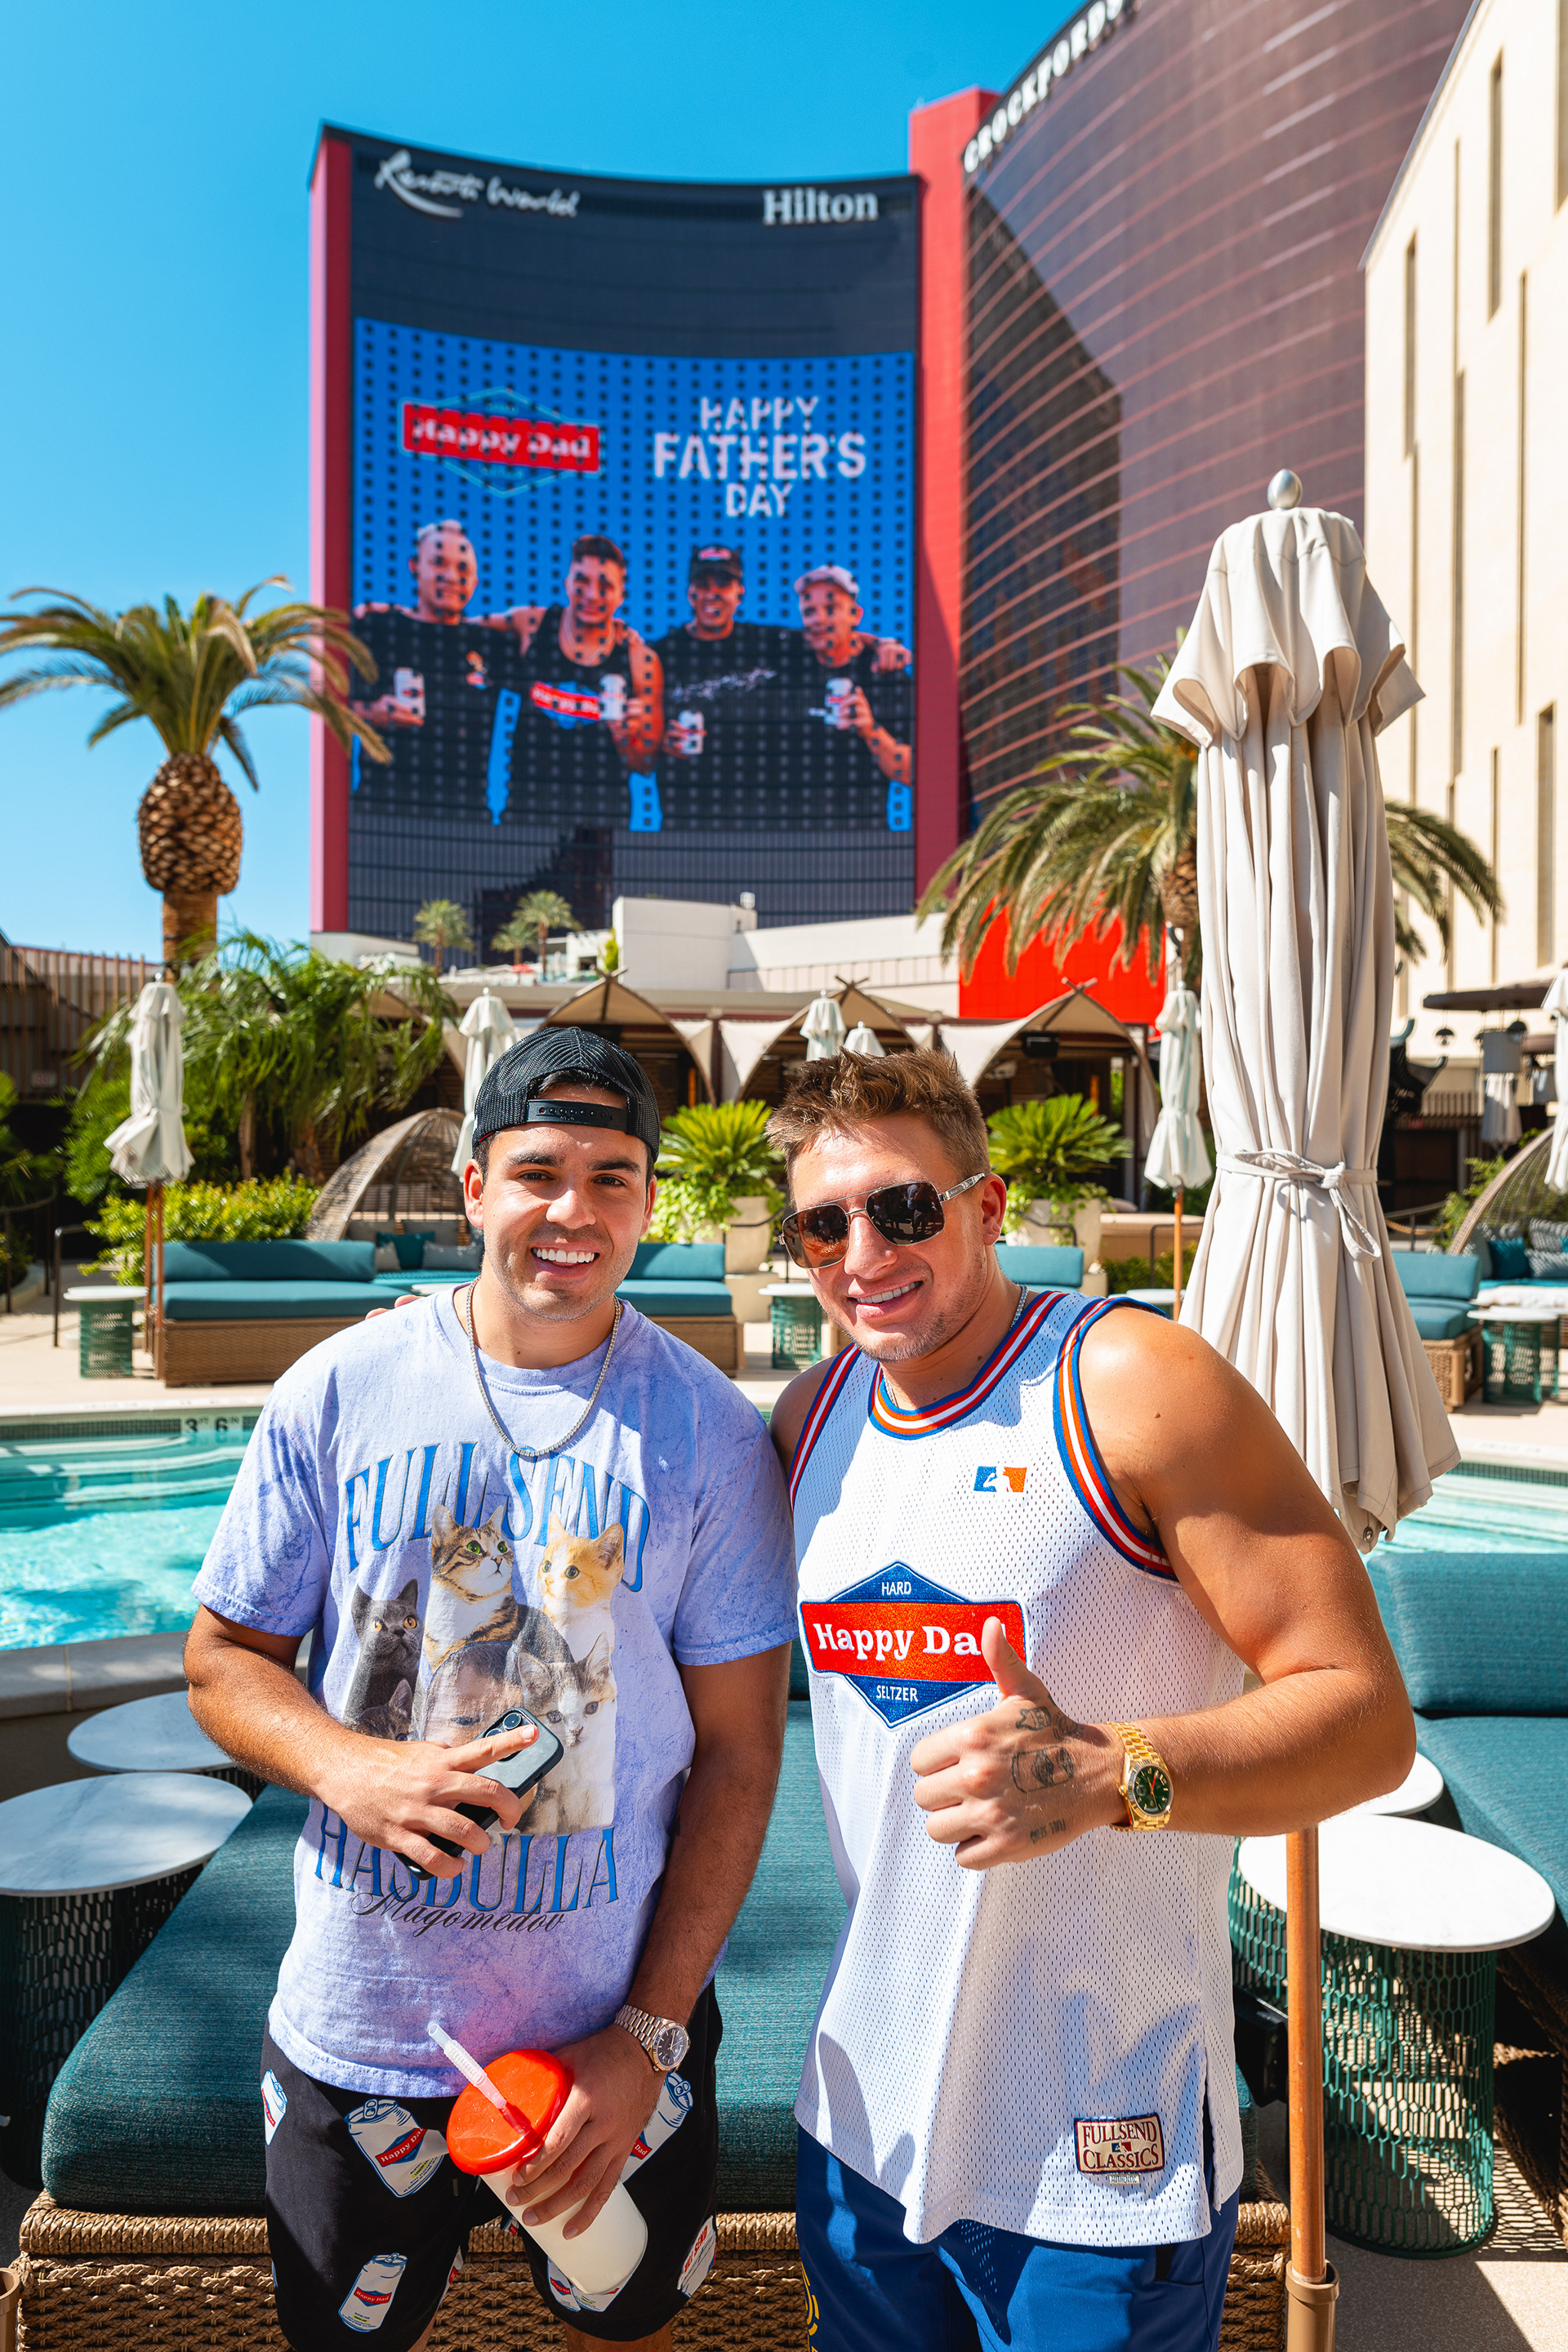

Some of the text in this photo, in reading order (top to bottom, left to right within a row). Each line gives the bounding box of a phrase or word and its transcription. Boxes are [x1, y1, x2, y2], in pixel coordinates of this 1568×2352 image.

[763, 186, 879, 225] Hilton
[700, 396, 819, 432] HAPPY
[412, 418, 590, 458] Happy Dad
[654, 430, 866, 480] FATHER'S
[726, 482, 794, 517] DAY
[185, 1418, 198, 1432] 3
[216, 1417, 228, 1432] 6
[345, 1441, 651, 1592] FULL SEND
[881, 1581, 912, 1596] HARD
[813, 1623, 1006, 1661] Happy Da
[875, 1685, 919, 1702] SELTZER
[351, 1885, 565, 1938] Magomedov
[635, 2144, 648, 2155] Dad
[1082, 2121, 1157, 2148] FULLSEND
[381, 2142, 410, 2163] Happy
[1083, 2143, 1160, 2170] CLASSICS
[356, 2290, 375, 2301] Happy
